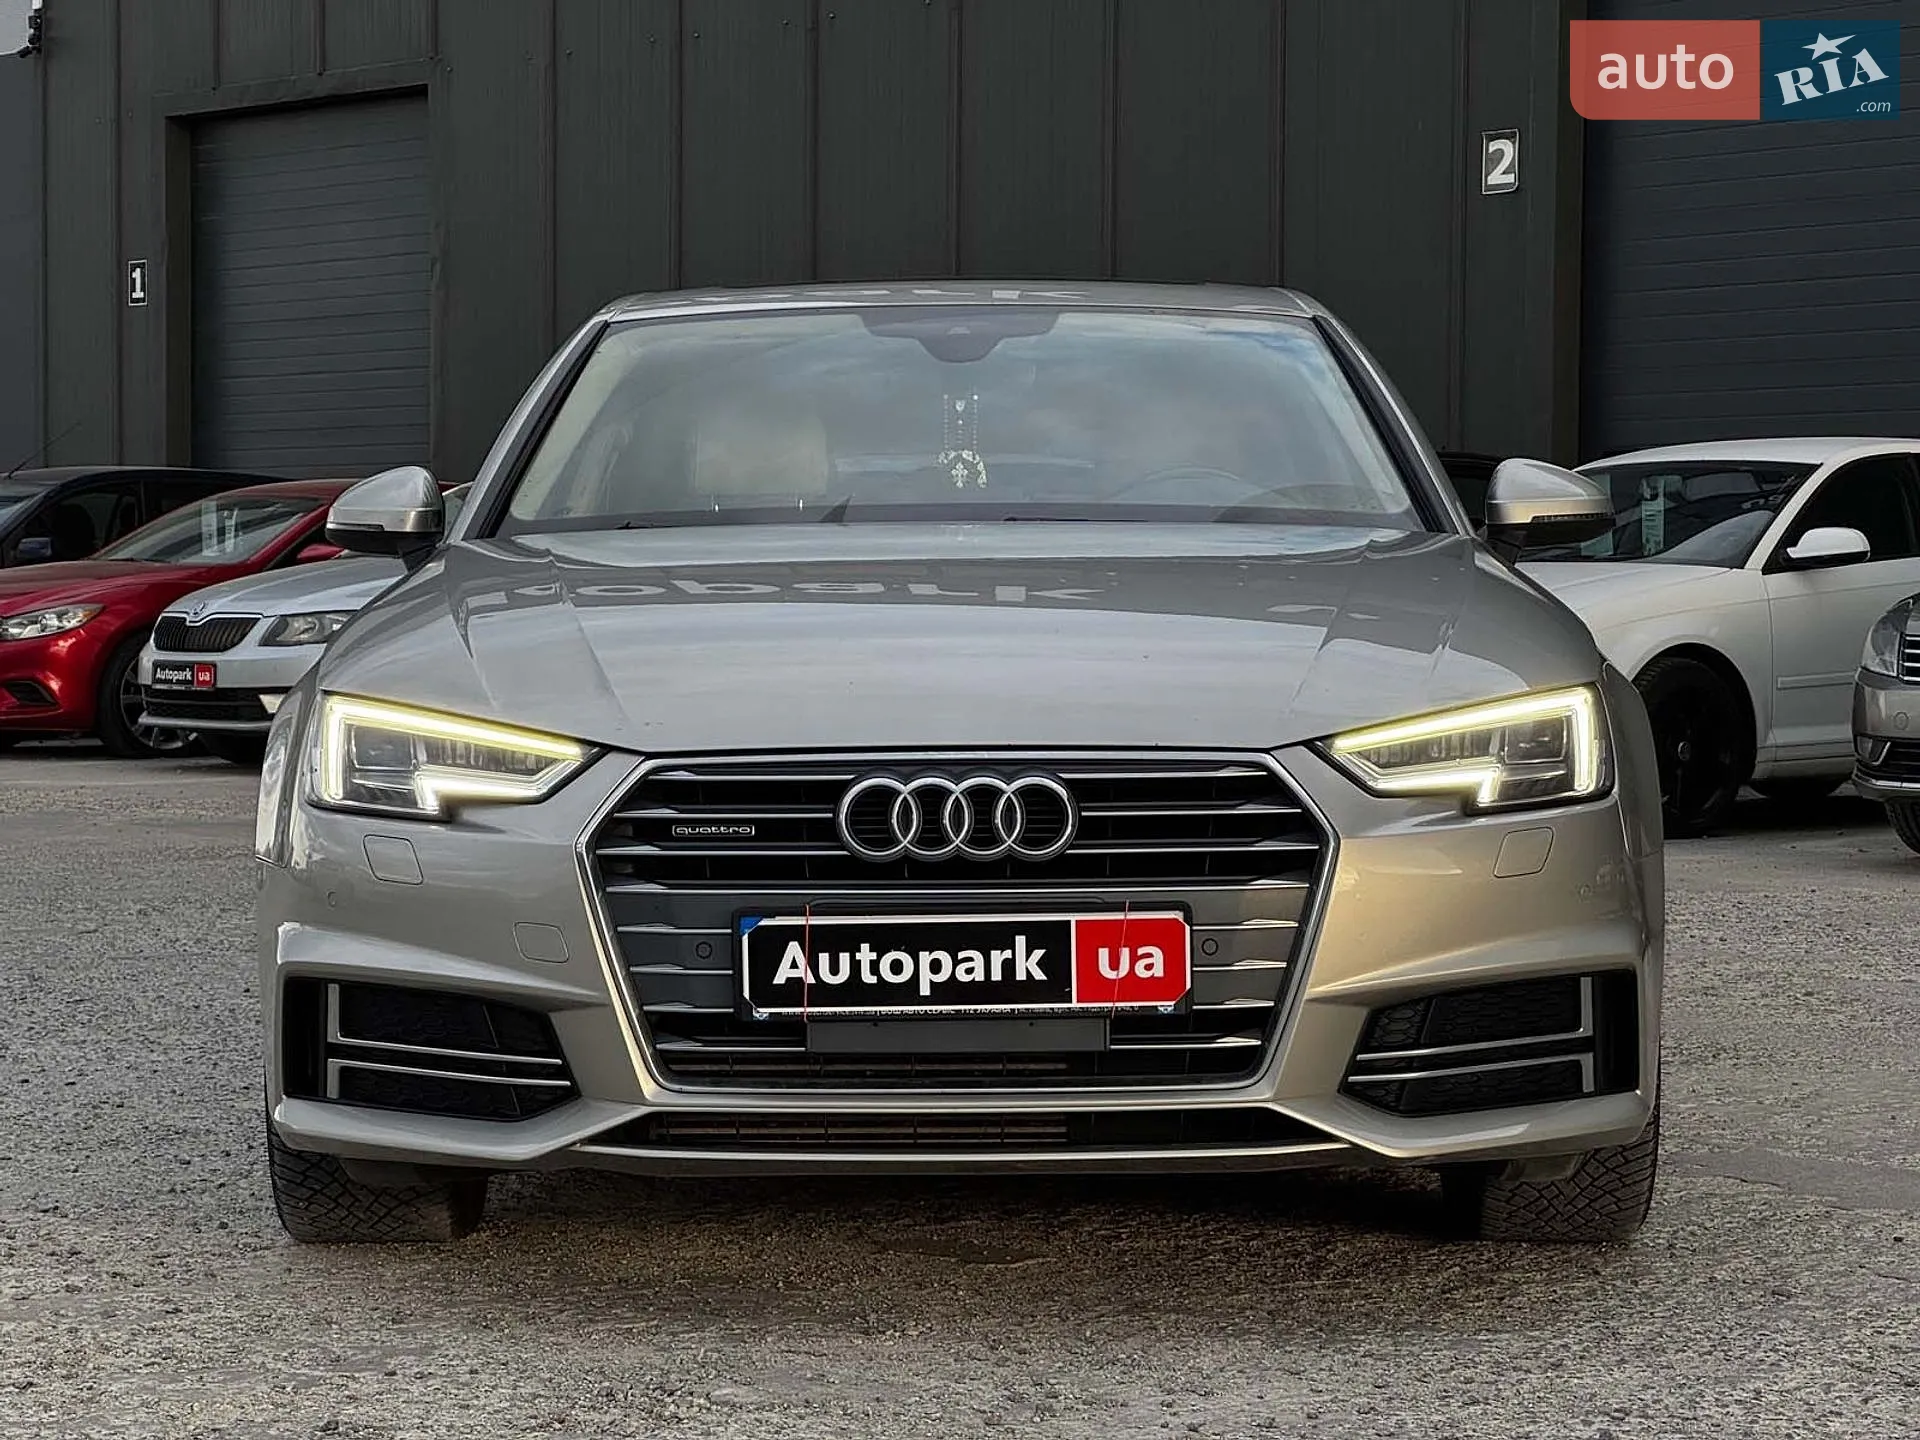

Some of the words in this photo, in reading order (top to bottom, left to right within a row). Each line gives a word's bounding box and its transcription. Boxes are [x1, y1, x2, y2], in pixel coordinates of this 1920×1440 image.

[1486, 139, 1515, 185] 2
[132, 267, 144, 298] 1
[155, 667, 192, 682] Autopark
[198, 671, 210, 681] ua
[676, 826, 751, 836] quattro
[772, 936, 1048, 996] Autopark
[1098, 946, 1165, 980] ua
